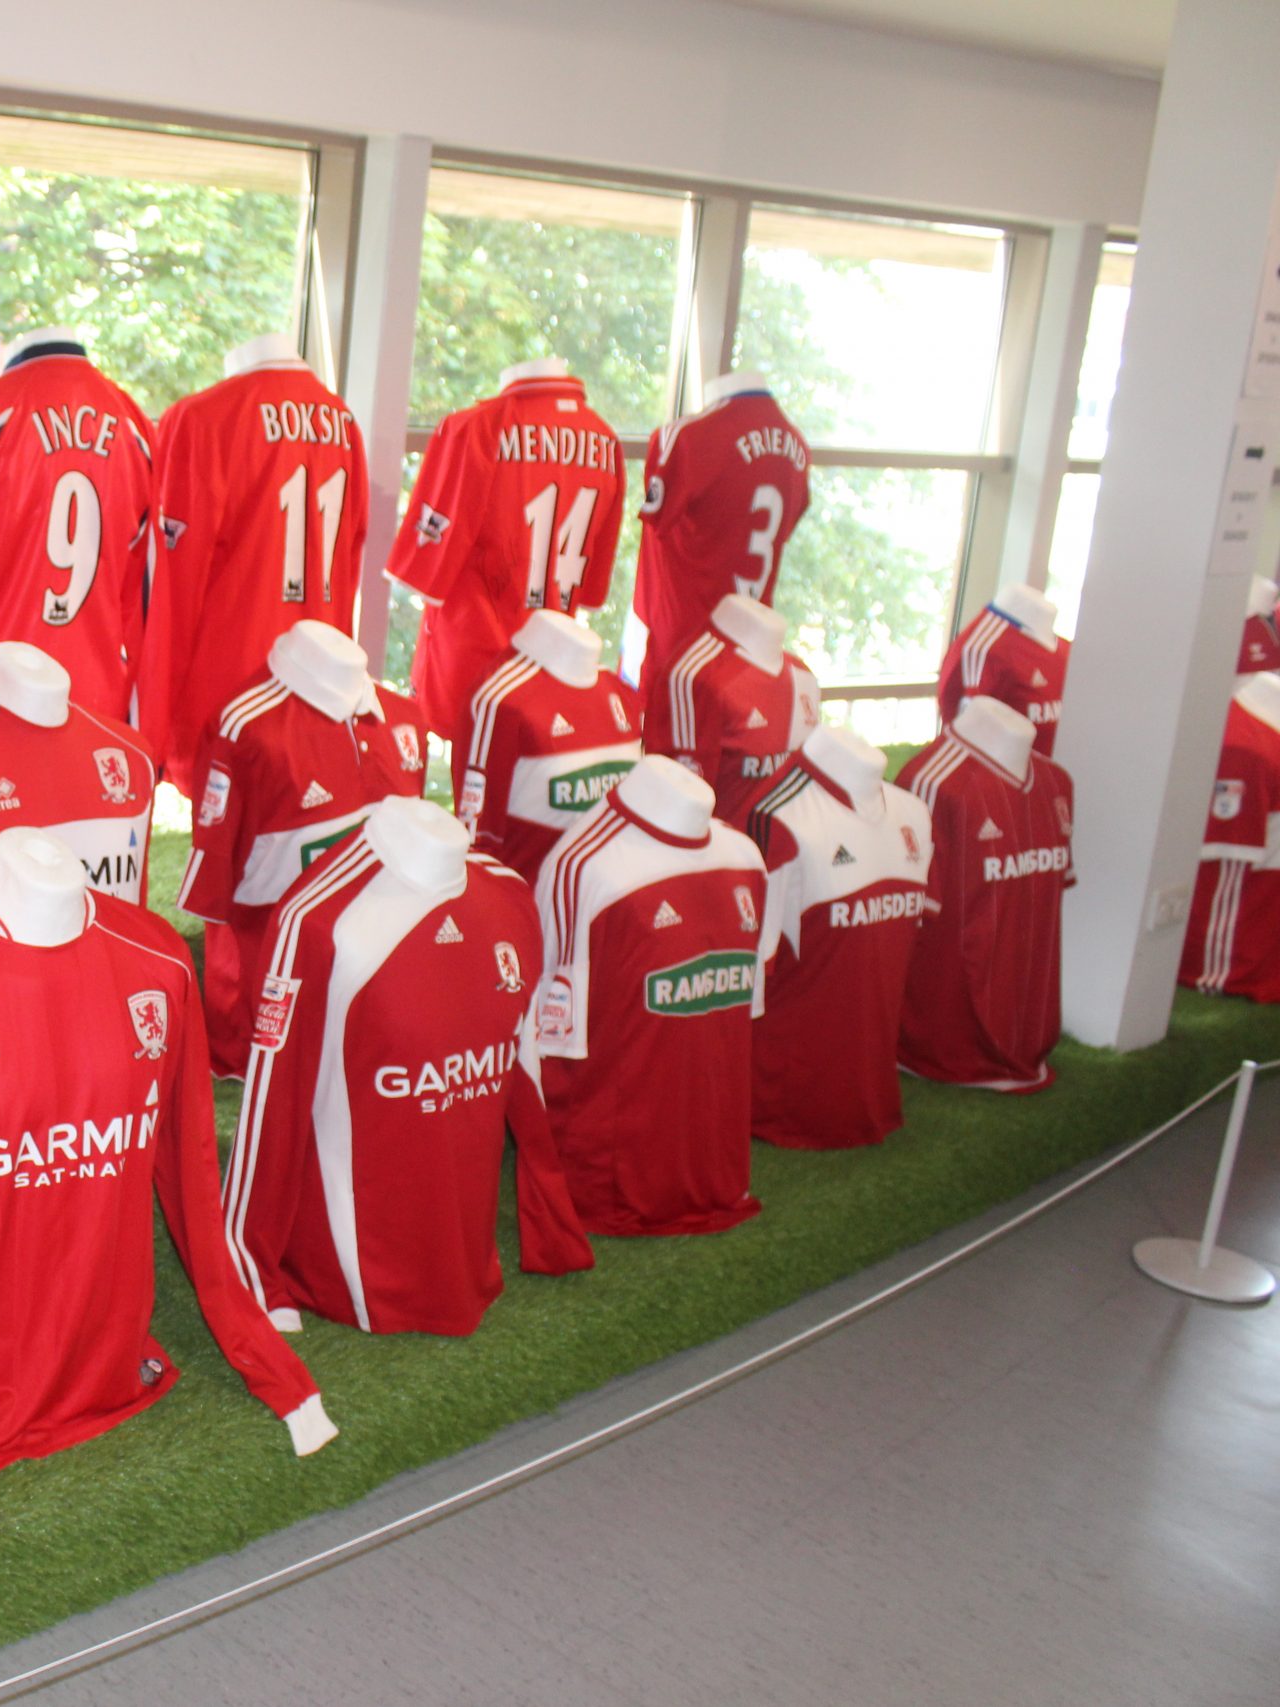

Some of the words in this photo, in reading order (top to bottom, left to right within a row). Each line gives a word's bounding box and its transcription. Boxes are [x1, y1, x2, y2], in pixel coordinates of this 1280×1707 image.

[32, 404, 118, 457] INCE
[735, 426, 806, 472] FRIEND
[42, 470, 101, 626] 9
[280, 463, 347, 602] 11
[524, 482, 598, 611] 14
[733, 484, 784, 600] 3
[830, 891, 925, 928] RAMSDEN
[655, 965, 756, 1004] RAMSDEN
